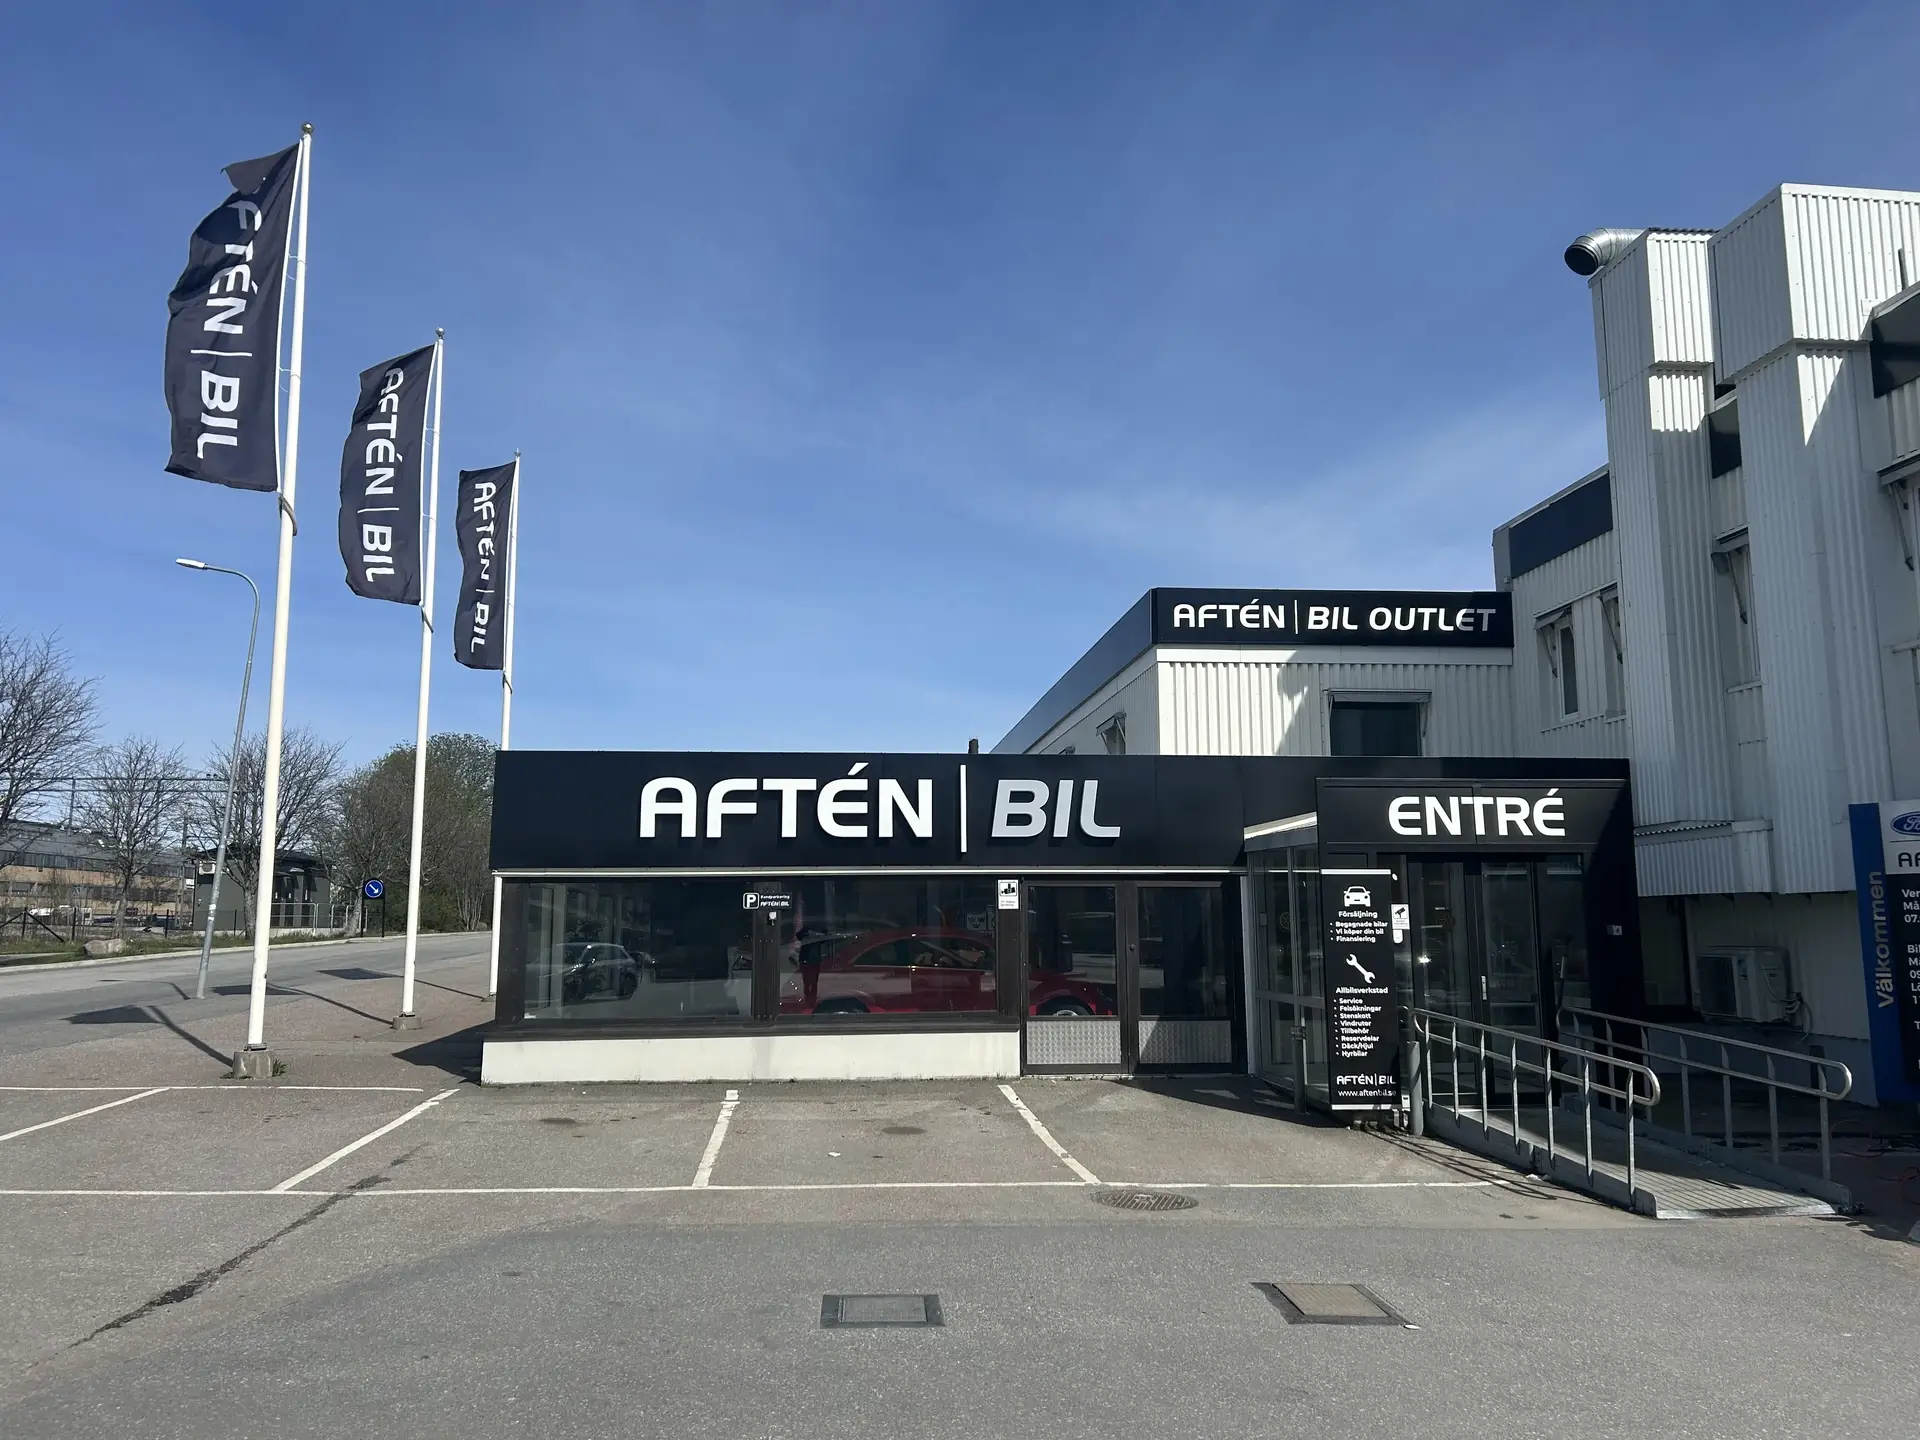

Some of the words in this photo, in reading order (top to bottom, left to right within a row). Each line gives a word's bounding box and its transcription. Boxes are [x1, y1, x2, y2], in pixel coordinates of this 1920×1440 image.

[203, 187, 262, 335] FTÉN
[197, 370, 240, 459] BIL
[364, 367, 403, 496] AFTÉN
[362, 523, 395, 583] BIL
[473, 482, 496, 580] AFTÉN
[470, 602, 491, 653] BIL
[1173, 599, 1285, 629] AFTÉN
[1307, 606, 1358, 630] BIL
[1369, 607, 1496, 632] OUTLET
[640, 763, 932, 838] AFTÉN
[992, 779, 1121, 838] BIL
[1388, 788, 1566, 836] ENTRÉ
[1338, 910, 1378, 919] Försäljning
[1336, 935, 1376, 943] Finansiering
[1869, 870, 1895, 1008] Välkommen
[1335, 986, 1388, 994] Allbilsverkstad
[1341, 1042, 1374, 1050] Däck/Hjul
[1341, 1050, 1368, 1058] Hyrbilar
[1336, 1073, 1374, 1085] AFTÉN
[1378, 1075, 1396, 1085] BIL
[1338, 1088, 1396, 1097] www.aftenbil.se
